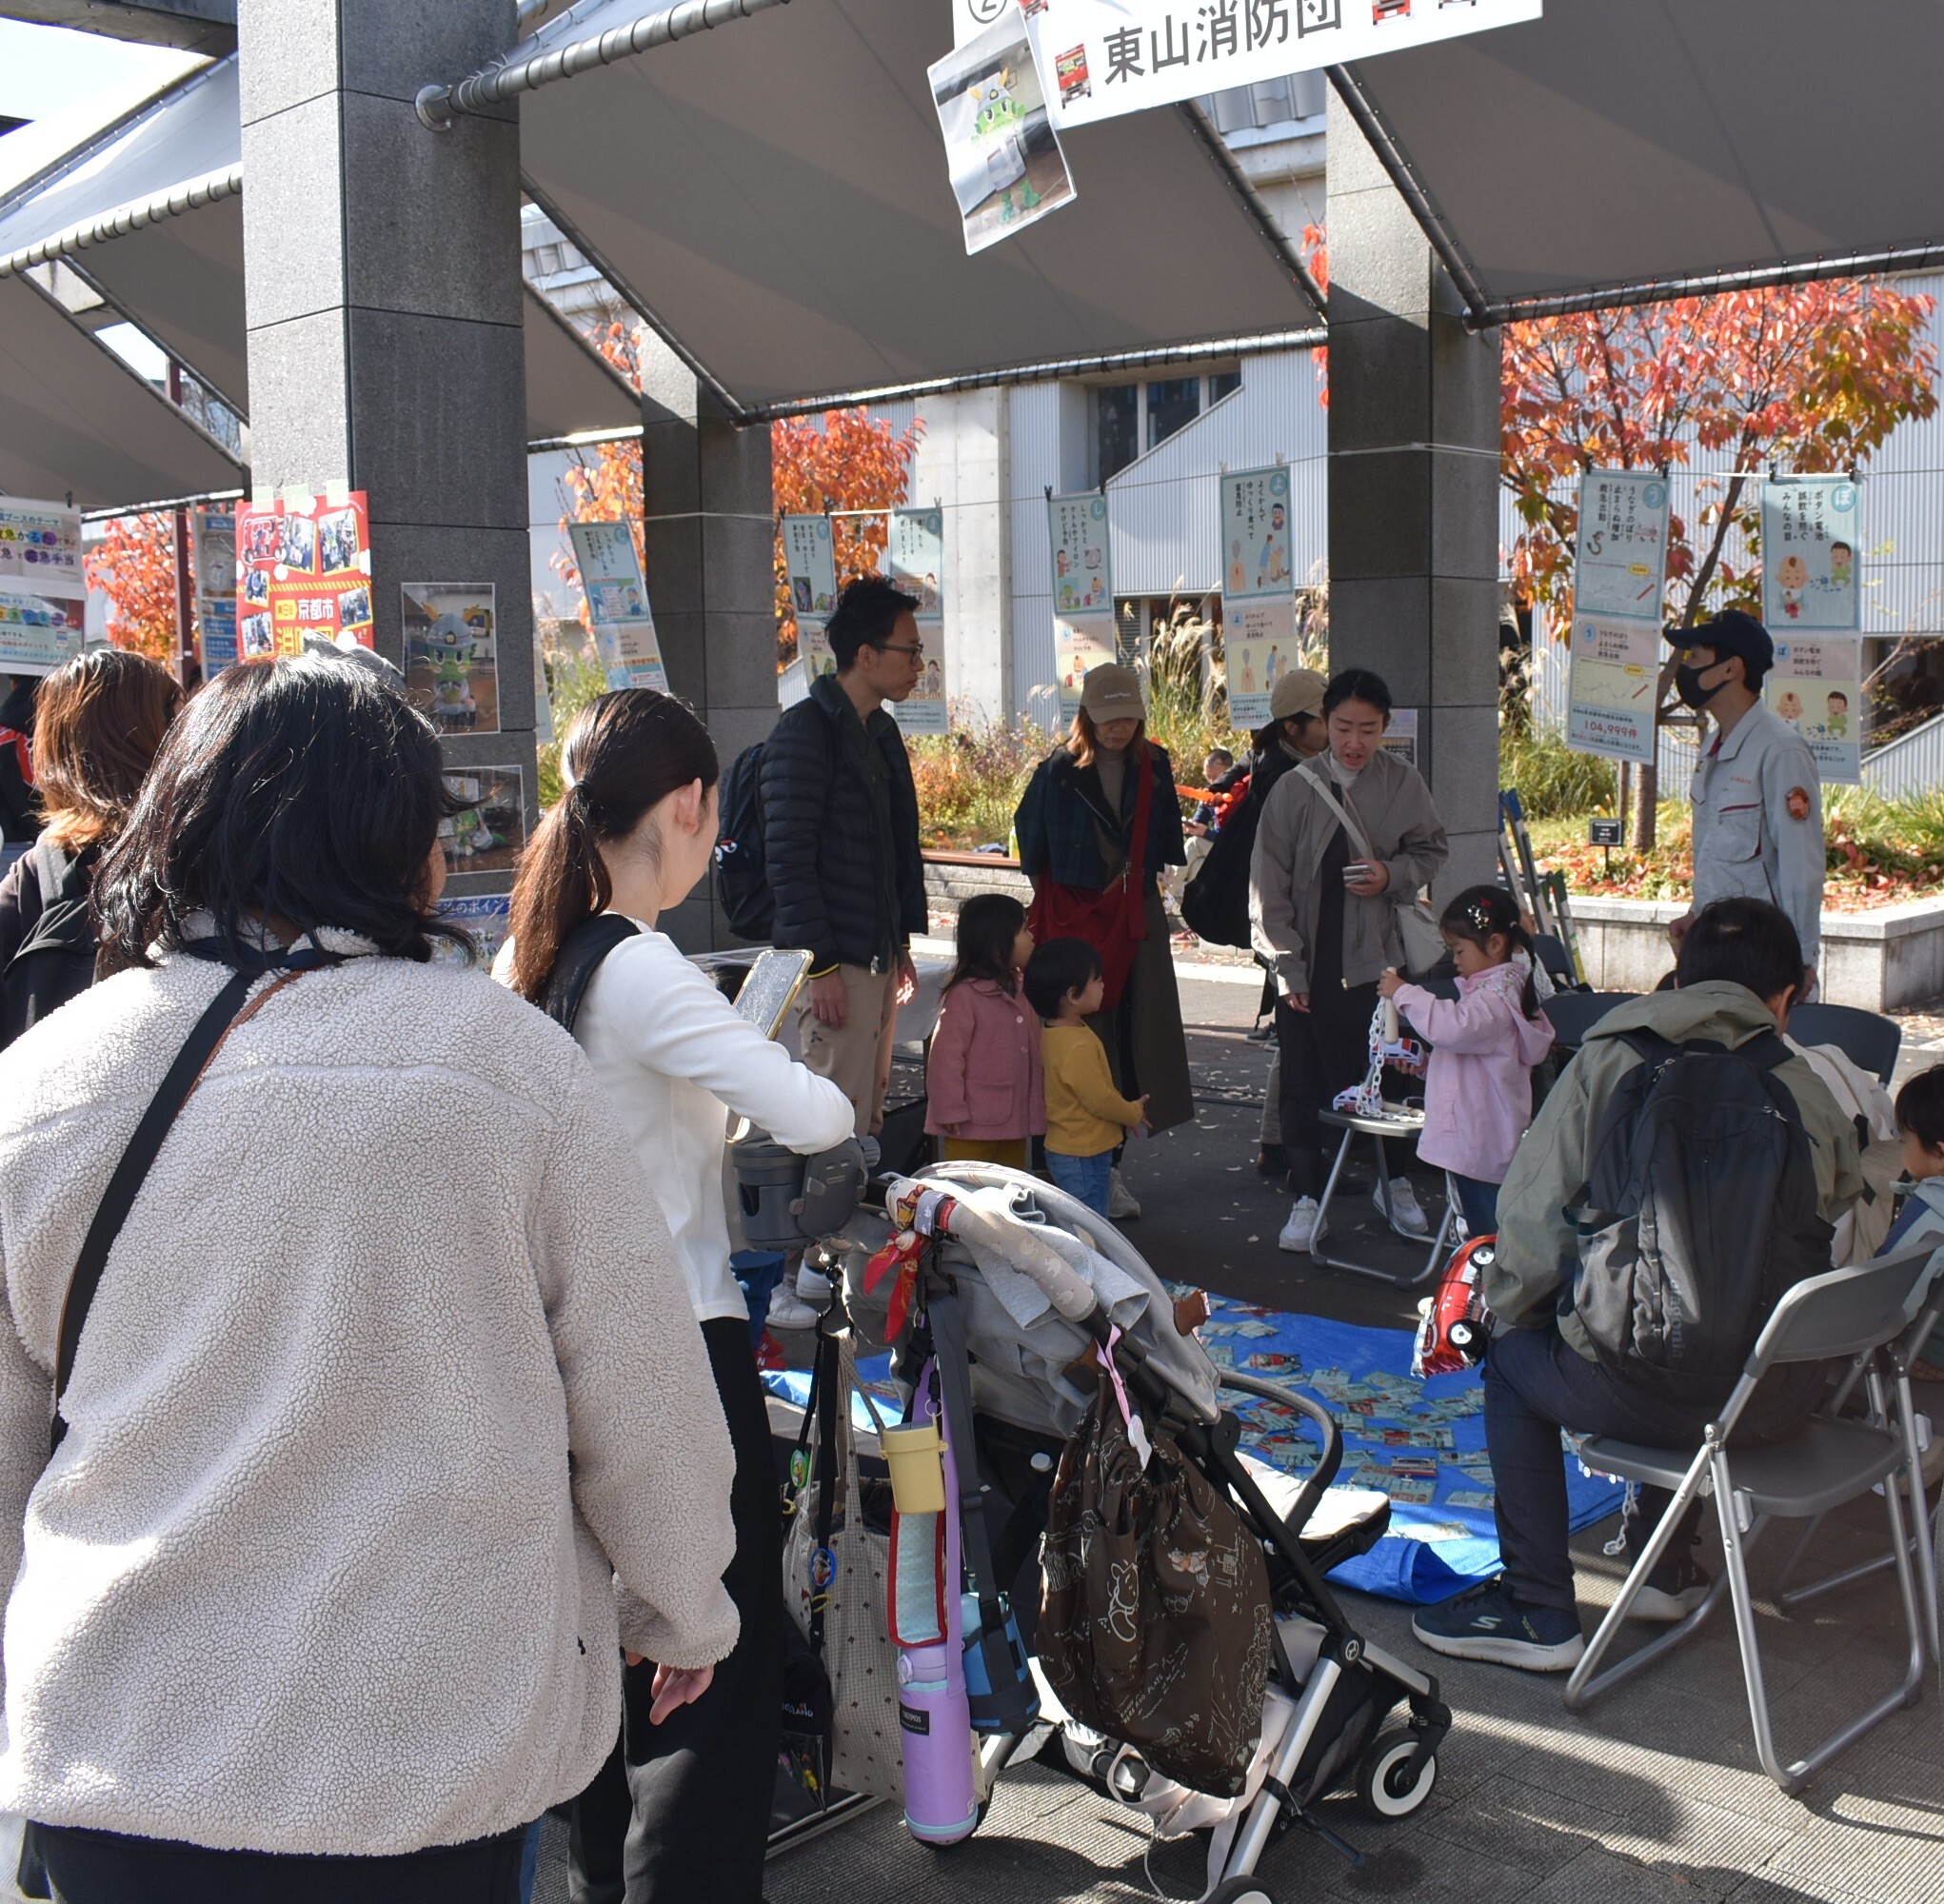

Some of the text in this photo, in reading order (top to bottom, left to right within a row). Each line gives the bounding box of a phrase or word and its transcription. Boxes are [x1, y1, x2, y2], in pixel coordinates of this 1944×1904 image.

[1102, 0, 1342, 86] 東山消防団
[1625, 486, 1636, 544] うなぎのぼり
[1814, 490, 1825, 542] ボタン電池
[297, 598, 334, 621] 京都市
